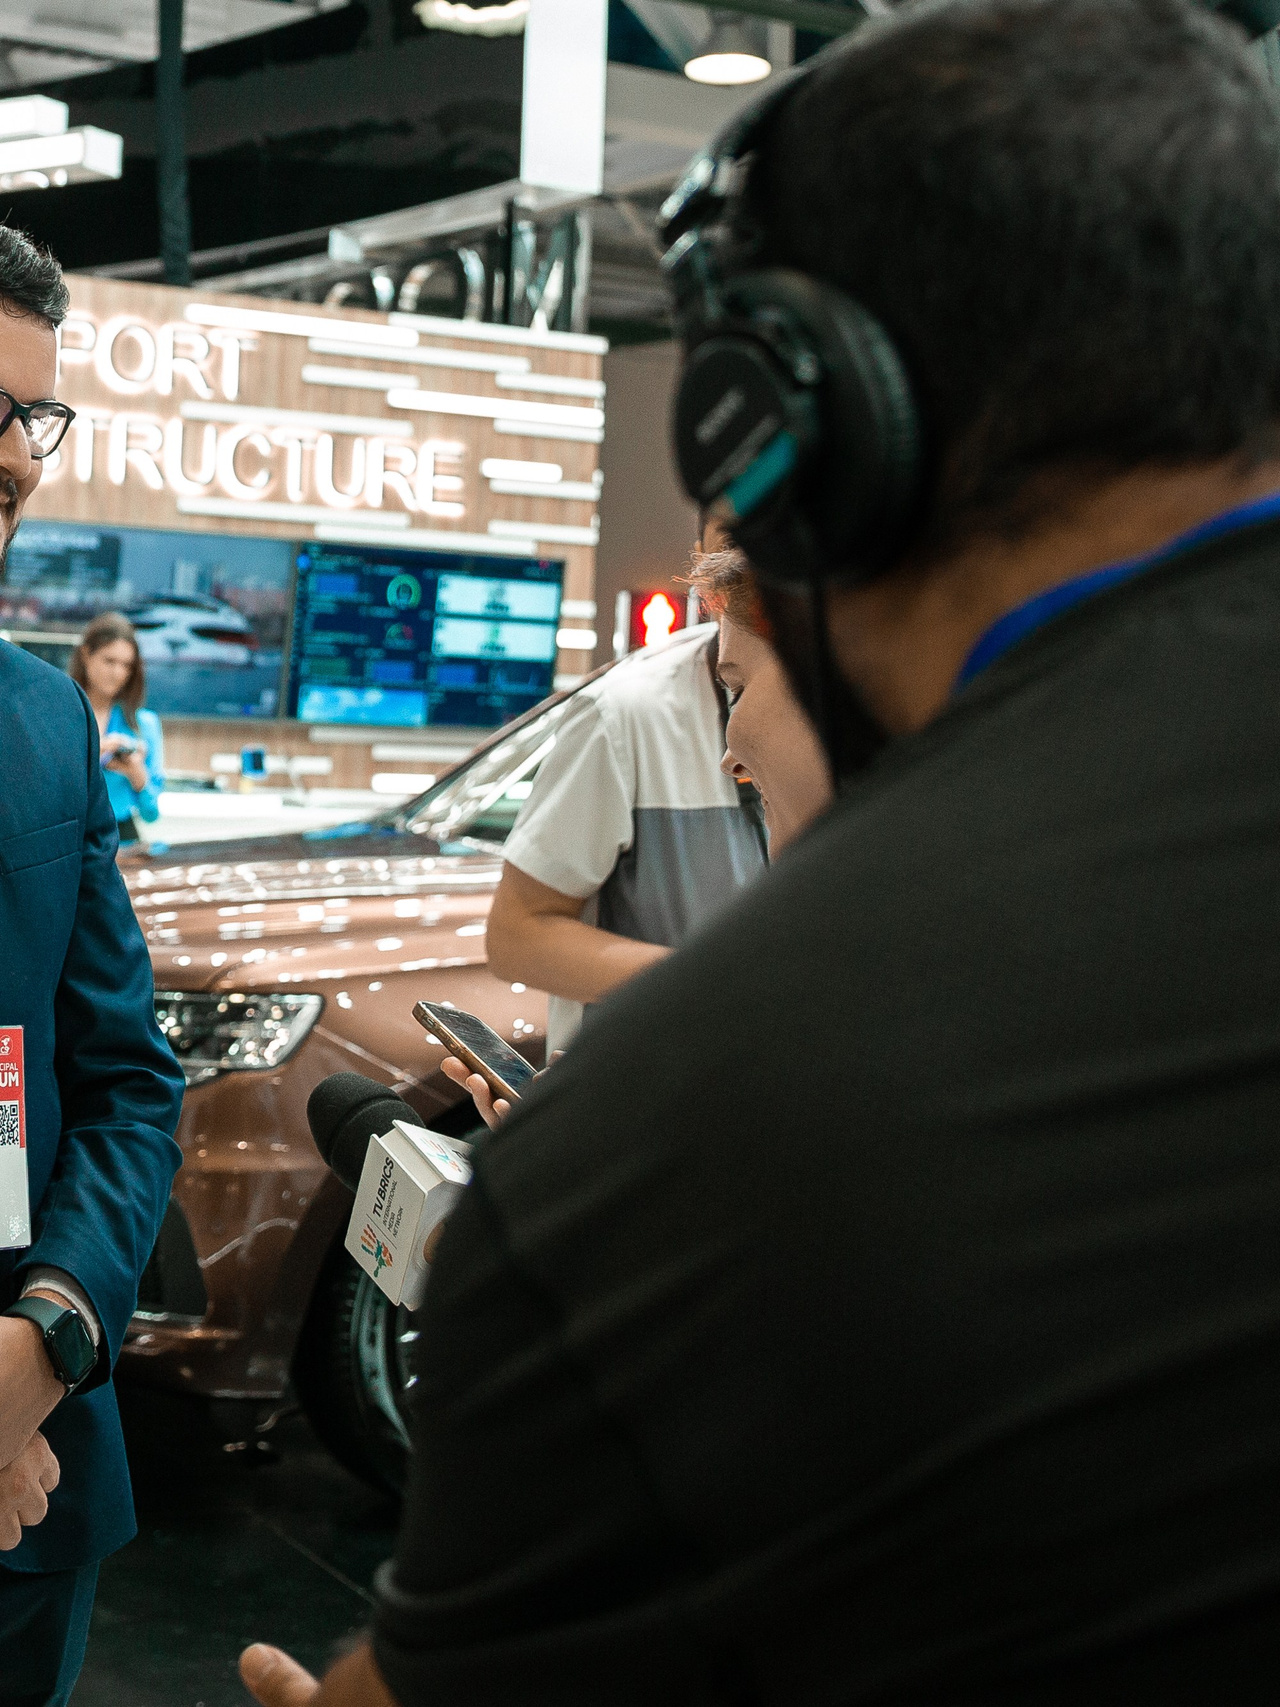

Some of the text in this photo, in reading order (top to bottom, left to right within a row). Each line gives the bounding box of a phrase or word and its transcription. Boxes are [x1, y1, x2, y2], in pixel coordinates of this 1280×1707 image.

[43, 406, 467, 518] TRUCTURE
[372, 1156, 395, 1218] TV BRICS
[382, 1180, 398, 1227] INTERNATIONAL
[387, 1211, 396, 1232] MEDIA
[393, 1205, 404, 1239] NETWORK
